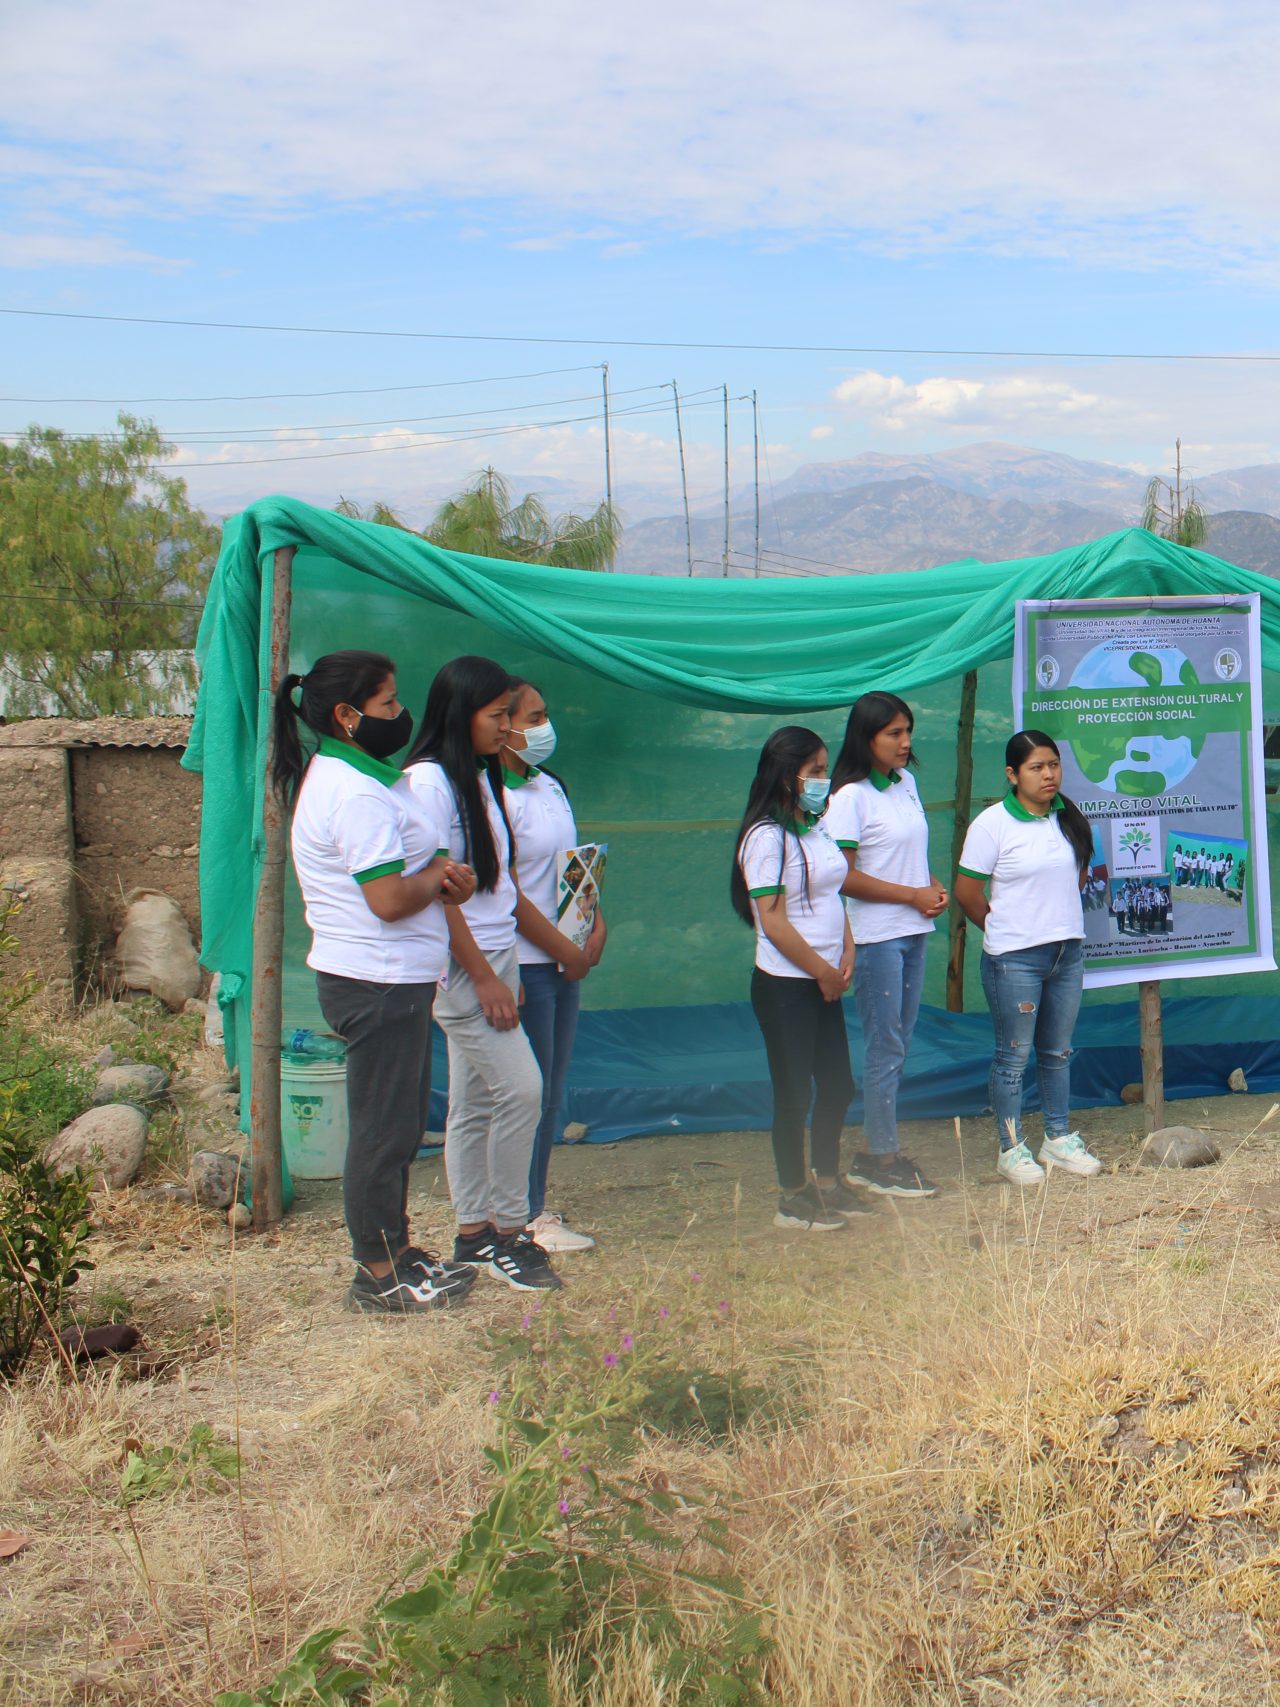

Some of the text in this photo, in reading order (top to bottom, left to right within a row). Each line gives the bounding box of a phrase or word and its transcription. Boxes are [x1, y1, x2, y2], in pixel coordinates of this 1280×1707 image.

[1056, 620, 1104, 628] UNIVERSIDAD
[1105, 619, 1140, 627] NACIONAL
[1182, 617, 1190, 625] DE
[1031, 692, 1244, 712] DIRECCIÓN DE EXTENSIÓN CULTURAL Y
[1077, 709, 1196, 724] PROYECCIÓN SOCIAL
[1079, 794, 1201, 812] IMPACTO VITAL
[1203, 940, 1230, 948] Ayacucho
